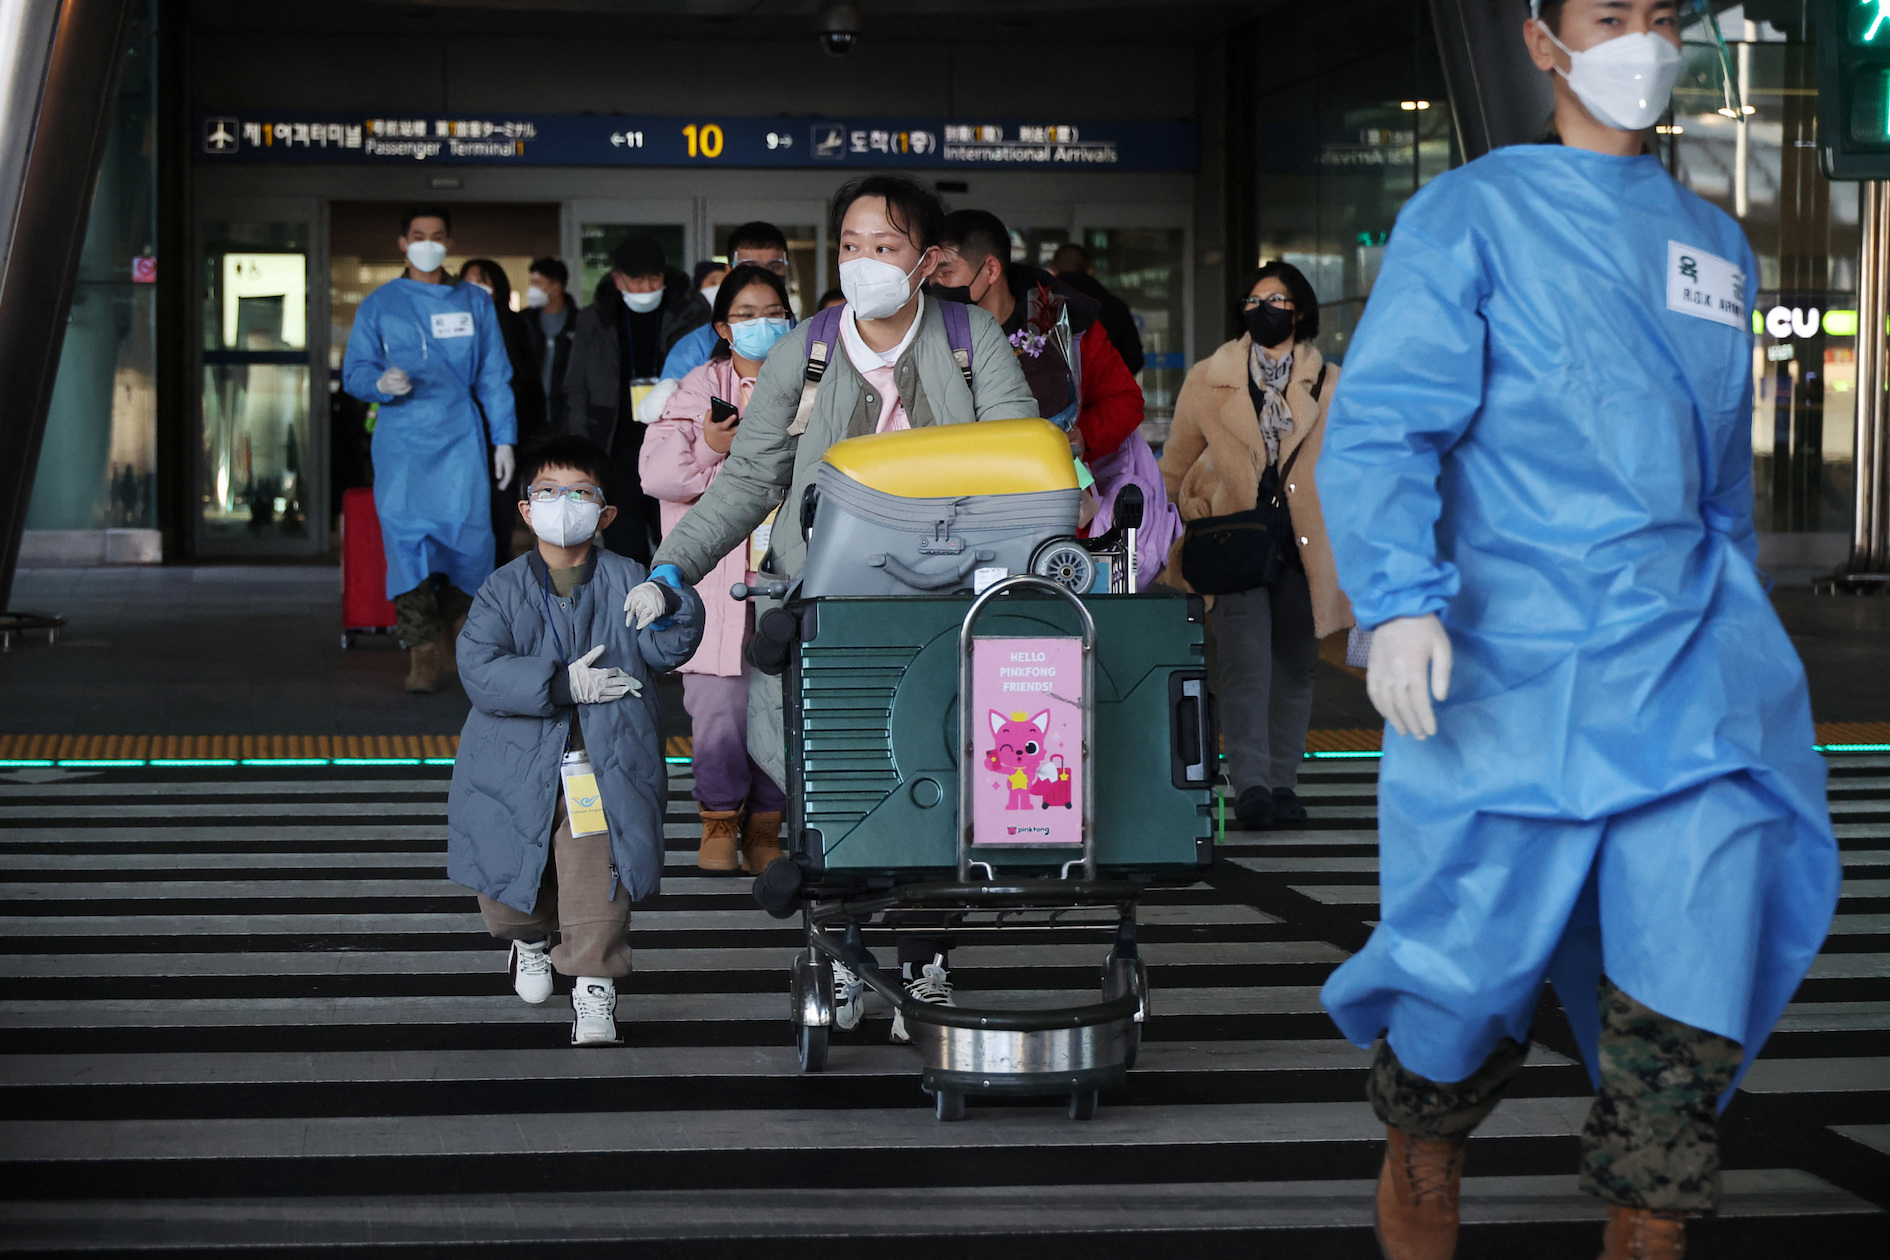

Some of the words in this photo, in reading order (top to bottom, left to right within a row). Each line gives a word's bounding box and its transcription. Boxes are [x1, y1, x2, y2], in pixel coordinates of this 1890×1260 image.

[625, 130, 643, 148] 11
[682, 123, 724, 158] 10
[766, 132, 780, 150] 9
[365, 138, 441, 160] Passenger
[943, 145, 1050, 162] International
[1053, 146, 1118, 163] Arrivals
[1766, 305, 1820, 339] CU
[1010, 652, 1046, 662] HELLO
[1000, 667, 1056, 677] PINKFONG
[1003, 681, 1053, 692] FRIENDS!
